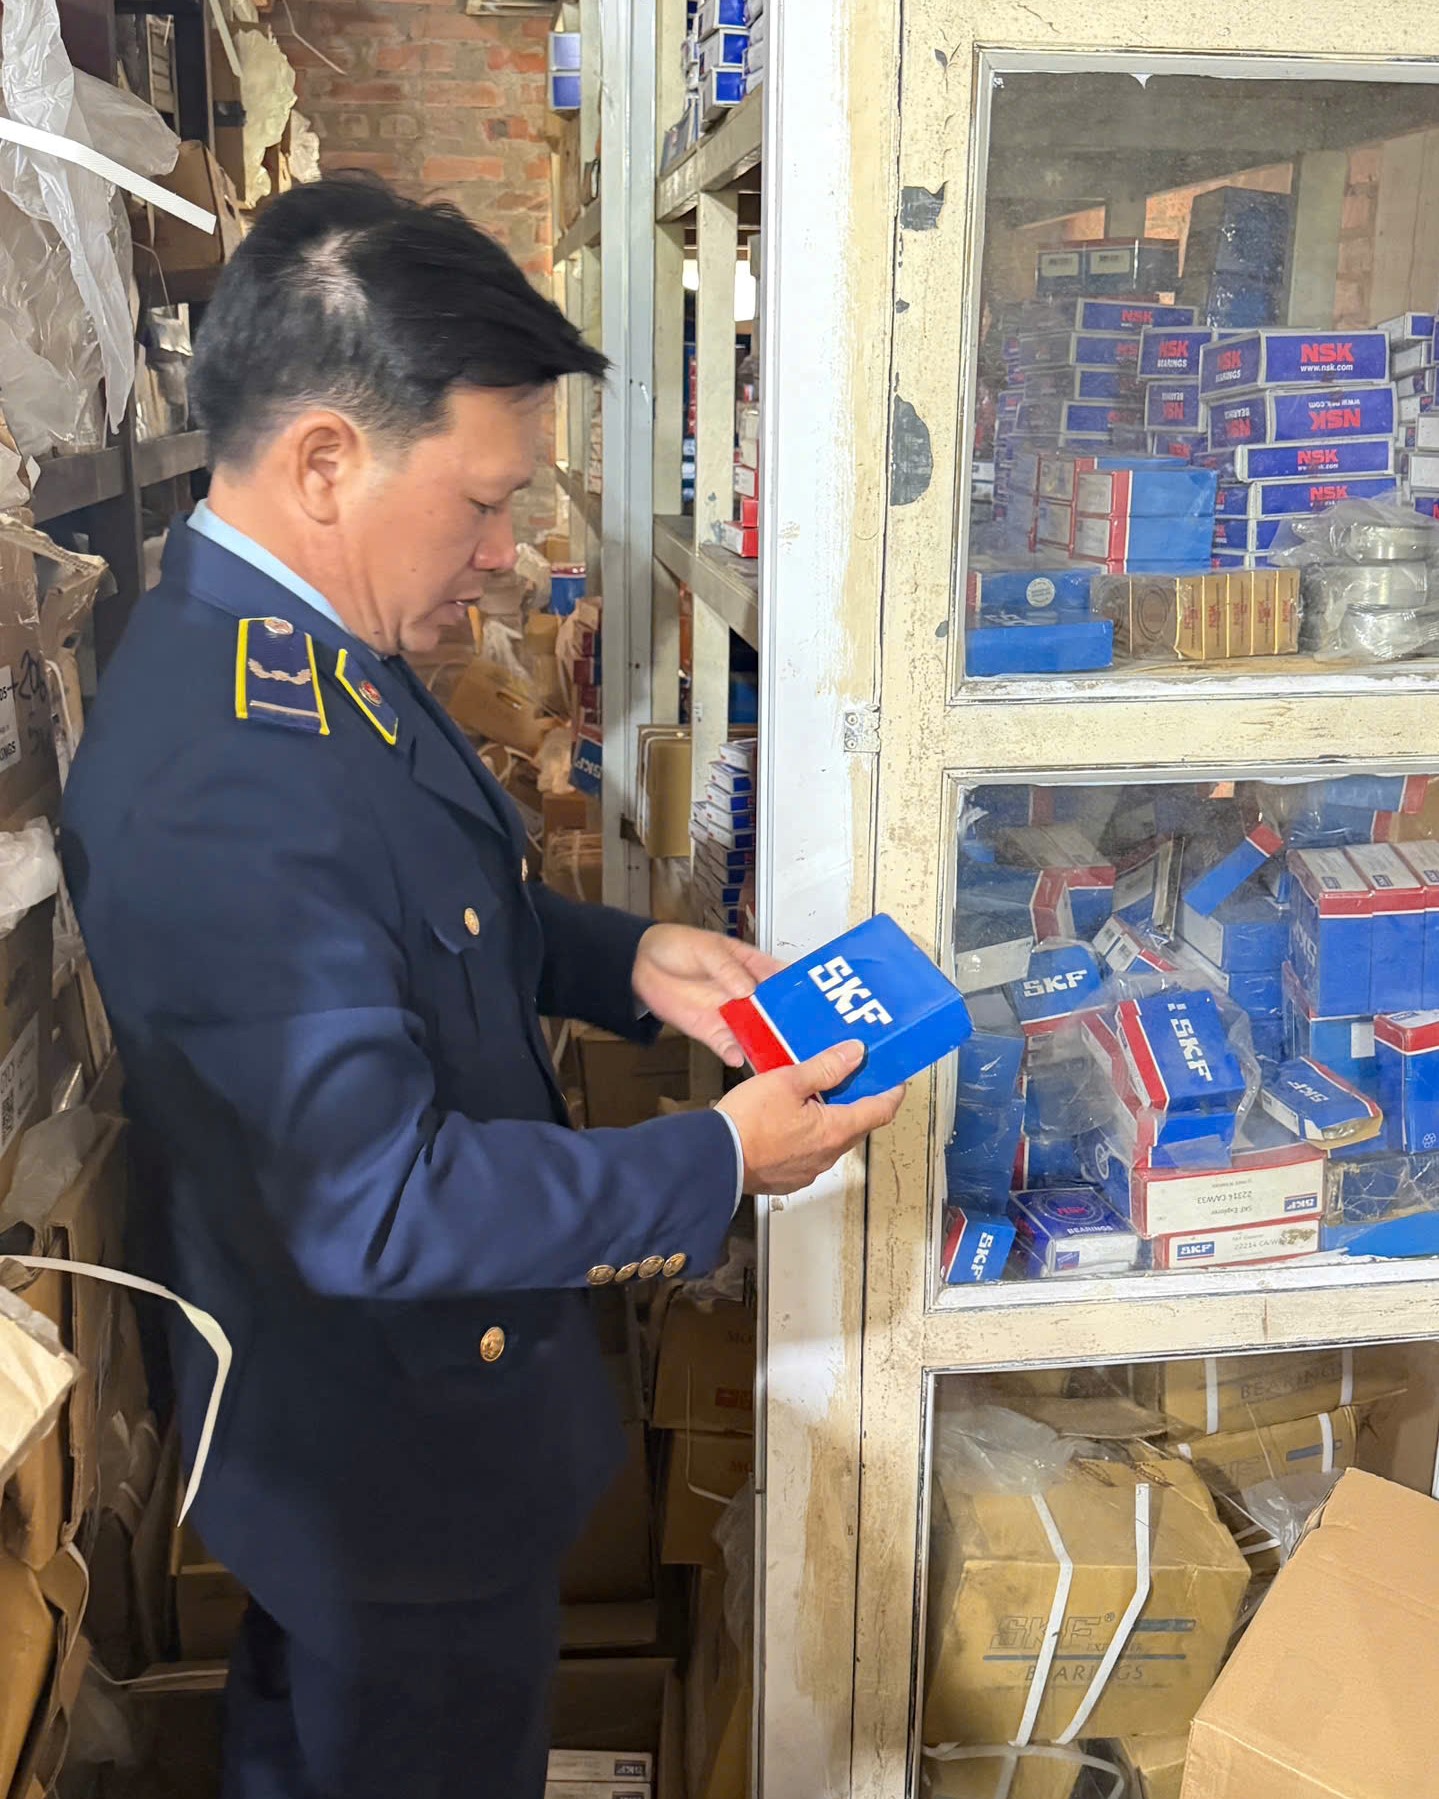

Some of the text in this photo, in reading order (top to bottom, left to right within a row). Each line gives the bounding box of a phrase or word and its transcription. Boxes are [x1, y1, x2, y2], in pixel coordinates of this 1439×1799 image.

[1159, 340, 1189, 358] NSK
[1300, 343, 1355, 363] NSK
[1157, 358, 1188, 368] BEARINGS
[1216, 350, 1242, 371] NSK
[1300, 363, 1353, 372] www.nsk.com
[1163, 401, 1185, 420] NSK
[1308, 409, 1361, 432] NSK
[1297, 449, 1339, 465] NSK
[1310, 484, 1349, 501] NSK
[807, 955, 893, 1025] SKF
[1023, 969, 1088, 998] SKF
[1169, 1018, 1214, 1082] SKF
[1286, 1080, 1330, 1103] SKF
[1286, 1197, 1316, 1211] SKF
[1066, 1224, 1114, 1235] BEARINGS
[971, 1231, 994, 1281] SKF
[1179, 1243, 1213, 1255] SKF
